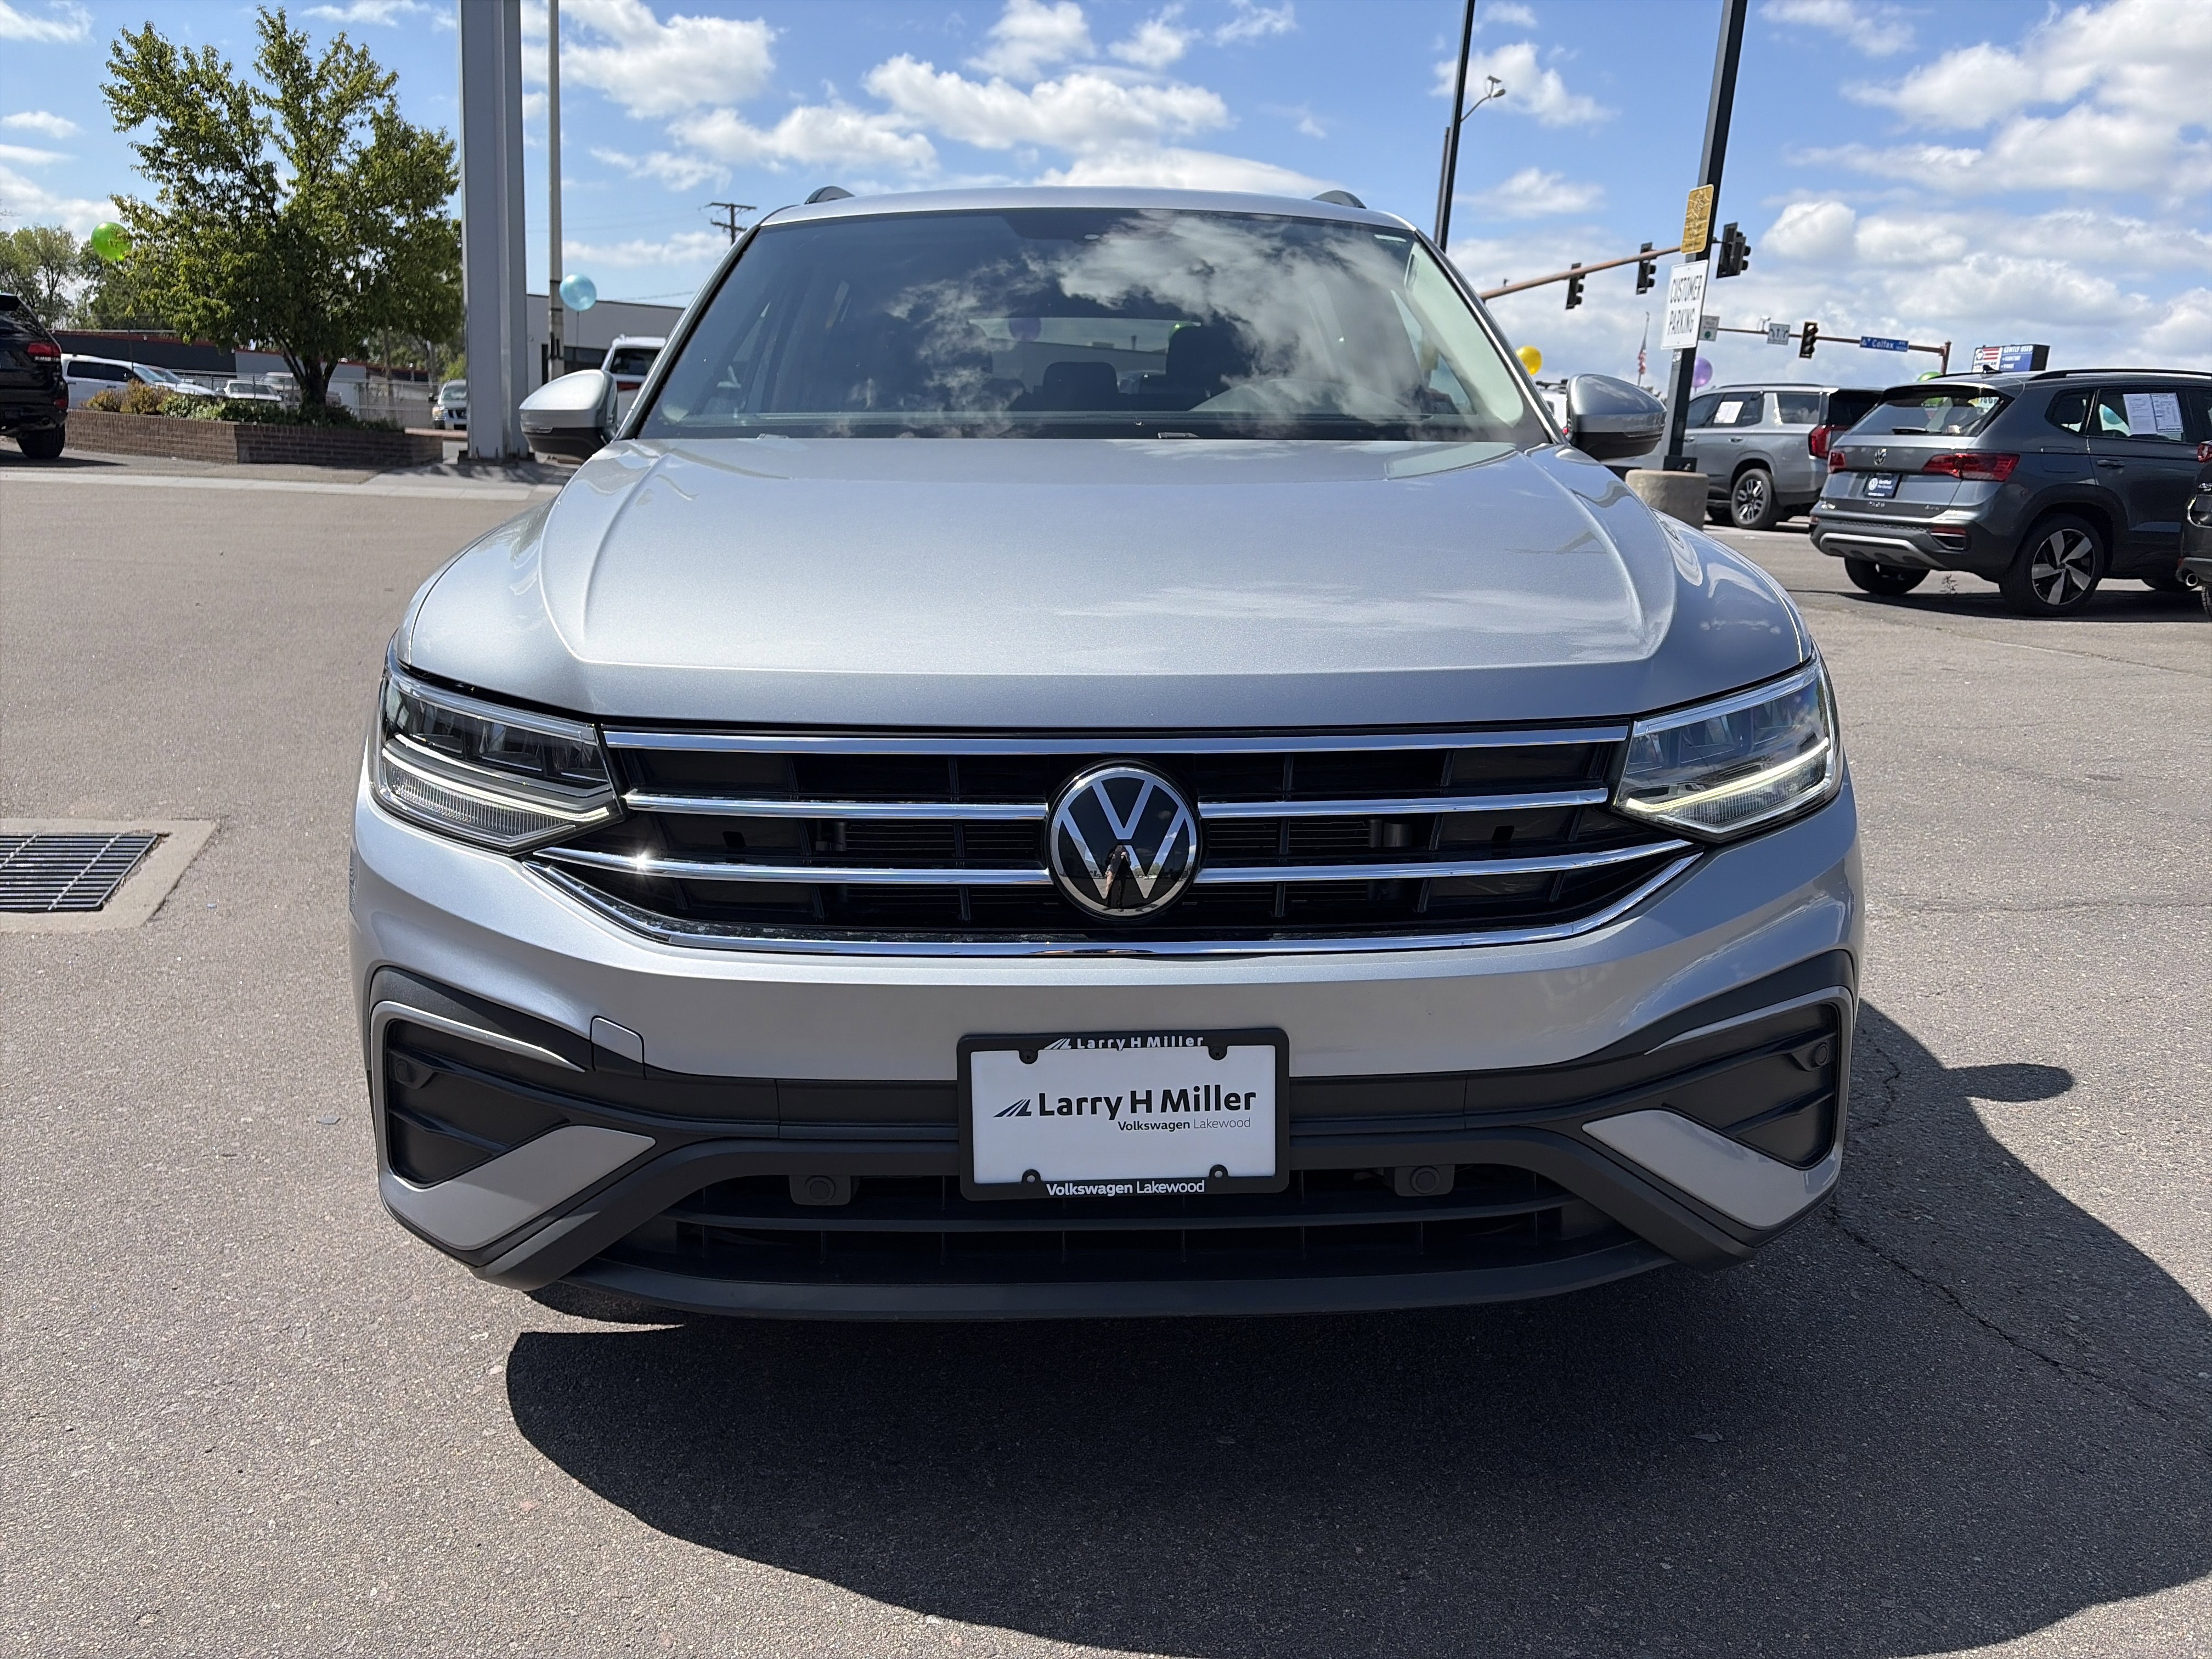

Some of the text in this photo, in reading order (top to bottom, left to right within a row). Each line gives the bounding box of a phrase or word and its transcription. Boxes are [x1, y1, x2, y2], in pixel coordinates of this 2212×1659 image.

[1670, 275, 1702, 303] CUSTOMER
[1668, 308, 1695, 335] PARKING
[1872, 339, 1894, 349] Colfax
[1077, 1035, 1204, 1051] Larry H Miller
[1039, 1084, 1256, 1120] Larry H Miller
[1118, 1117, 1251, 1132] Volkswagen Lakewood
[1046, 1180, 1205, 1197] Volkswagen Lakewood
